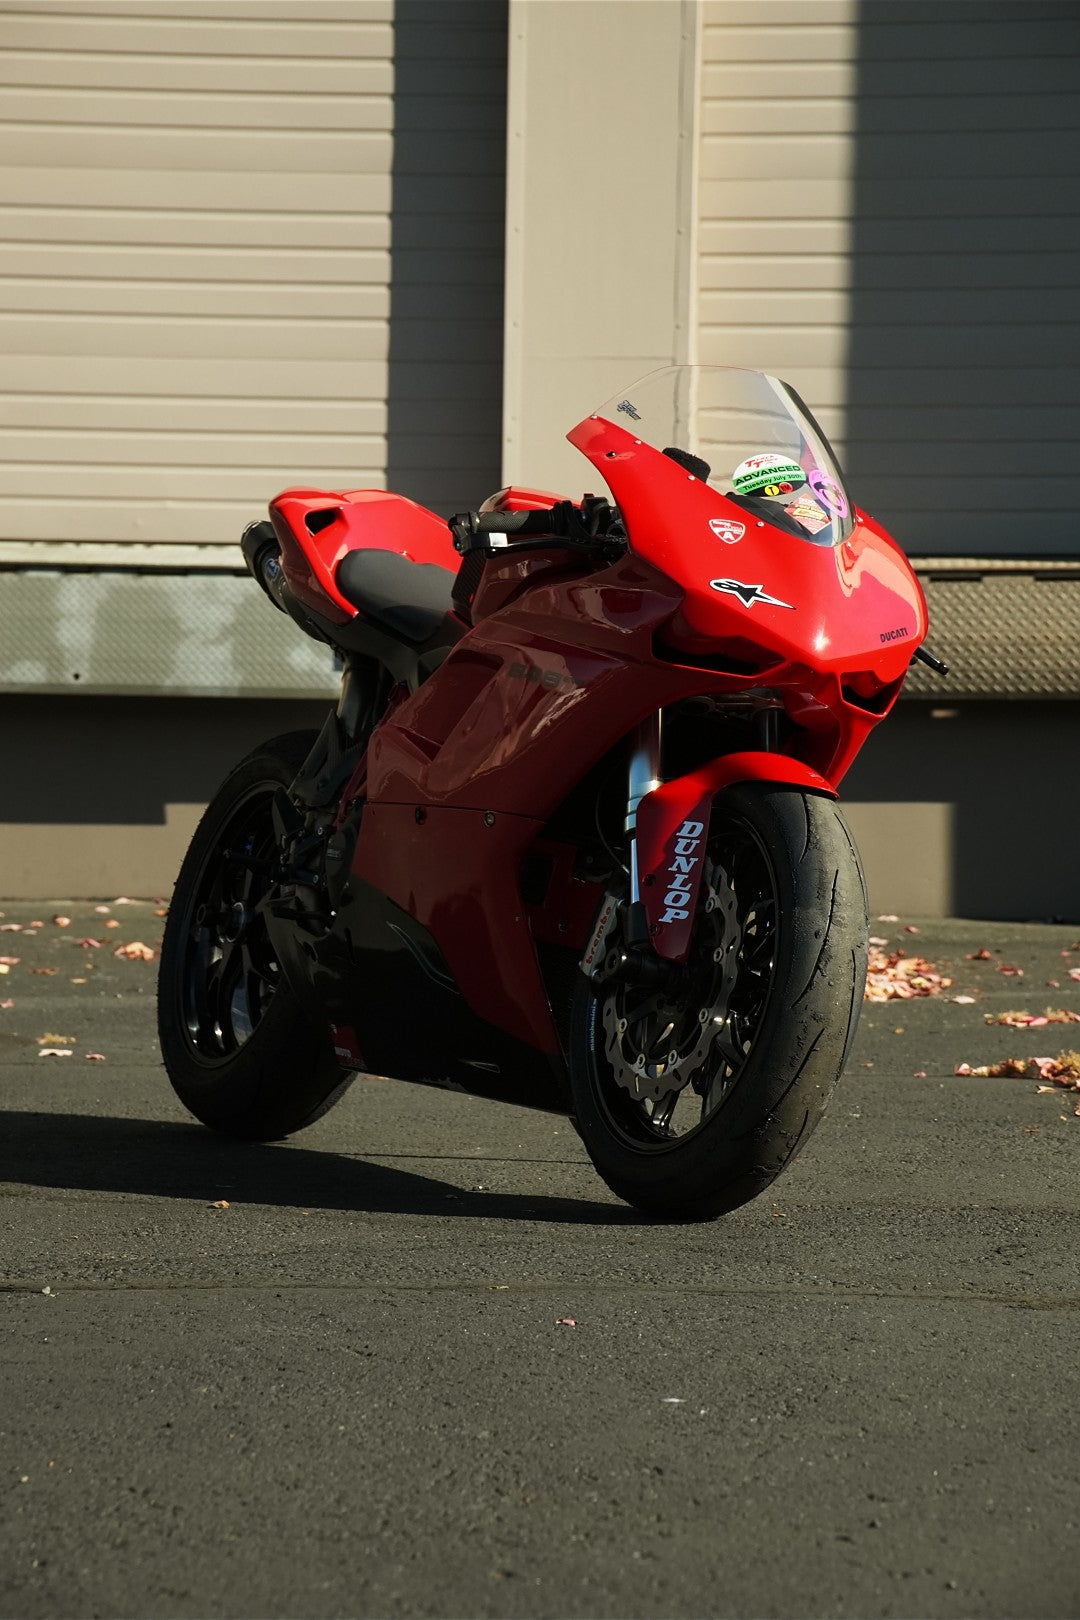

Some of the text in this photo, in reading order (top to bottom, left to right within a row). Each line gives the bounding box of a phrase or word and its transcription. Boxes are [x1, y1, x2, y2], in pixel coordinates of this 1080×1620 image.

[735, 465, 801, 486] ADVANCED
[743, 478, 772, 491] Tuesday
[880, 627, 908, 643] DUCATI
[658, 820, 704, 923] DUNLOP
[585, 906, 611, 965] brembo
